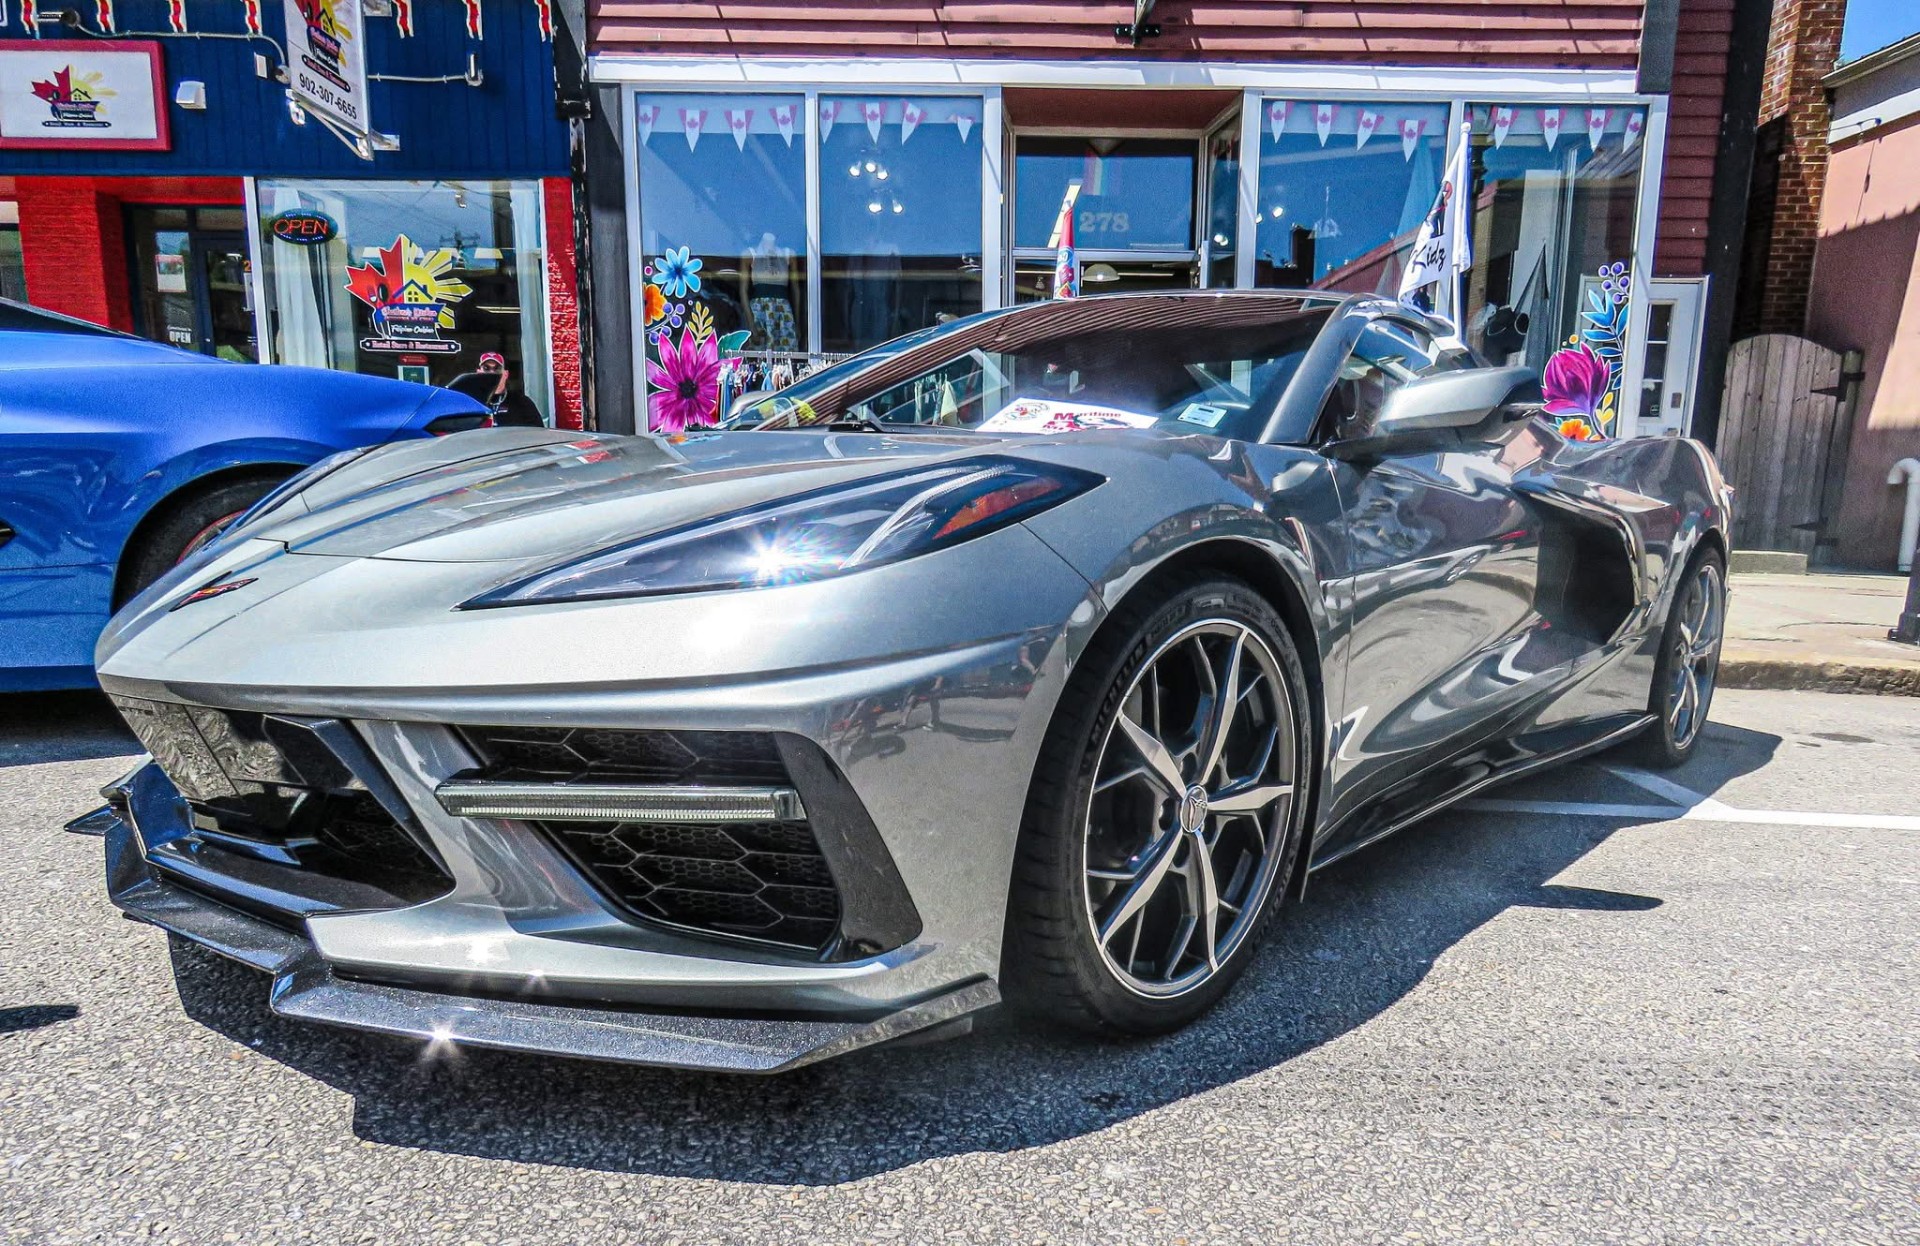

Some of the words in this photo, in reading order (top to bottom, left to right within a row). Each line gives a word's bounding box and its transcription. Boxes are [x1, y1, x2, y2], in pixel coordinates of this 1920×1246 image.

[299, 73, 357, 120] 902-307-6655
[274, 218, 328, 235] OPEN
[1080, 211, 1129, 232] 278
[1412, 240, 1446, 273] Kidz
[169, 330, 191, 344] OPEN
[1090, 635, 1148, 743] MICHELIN
